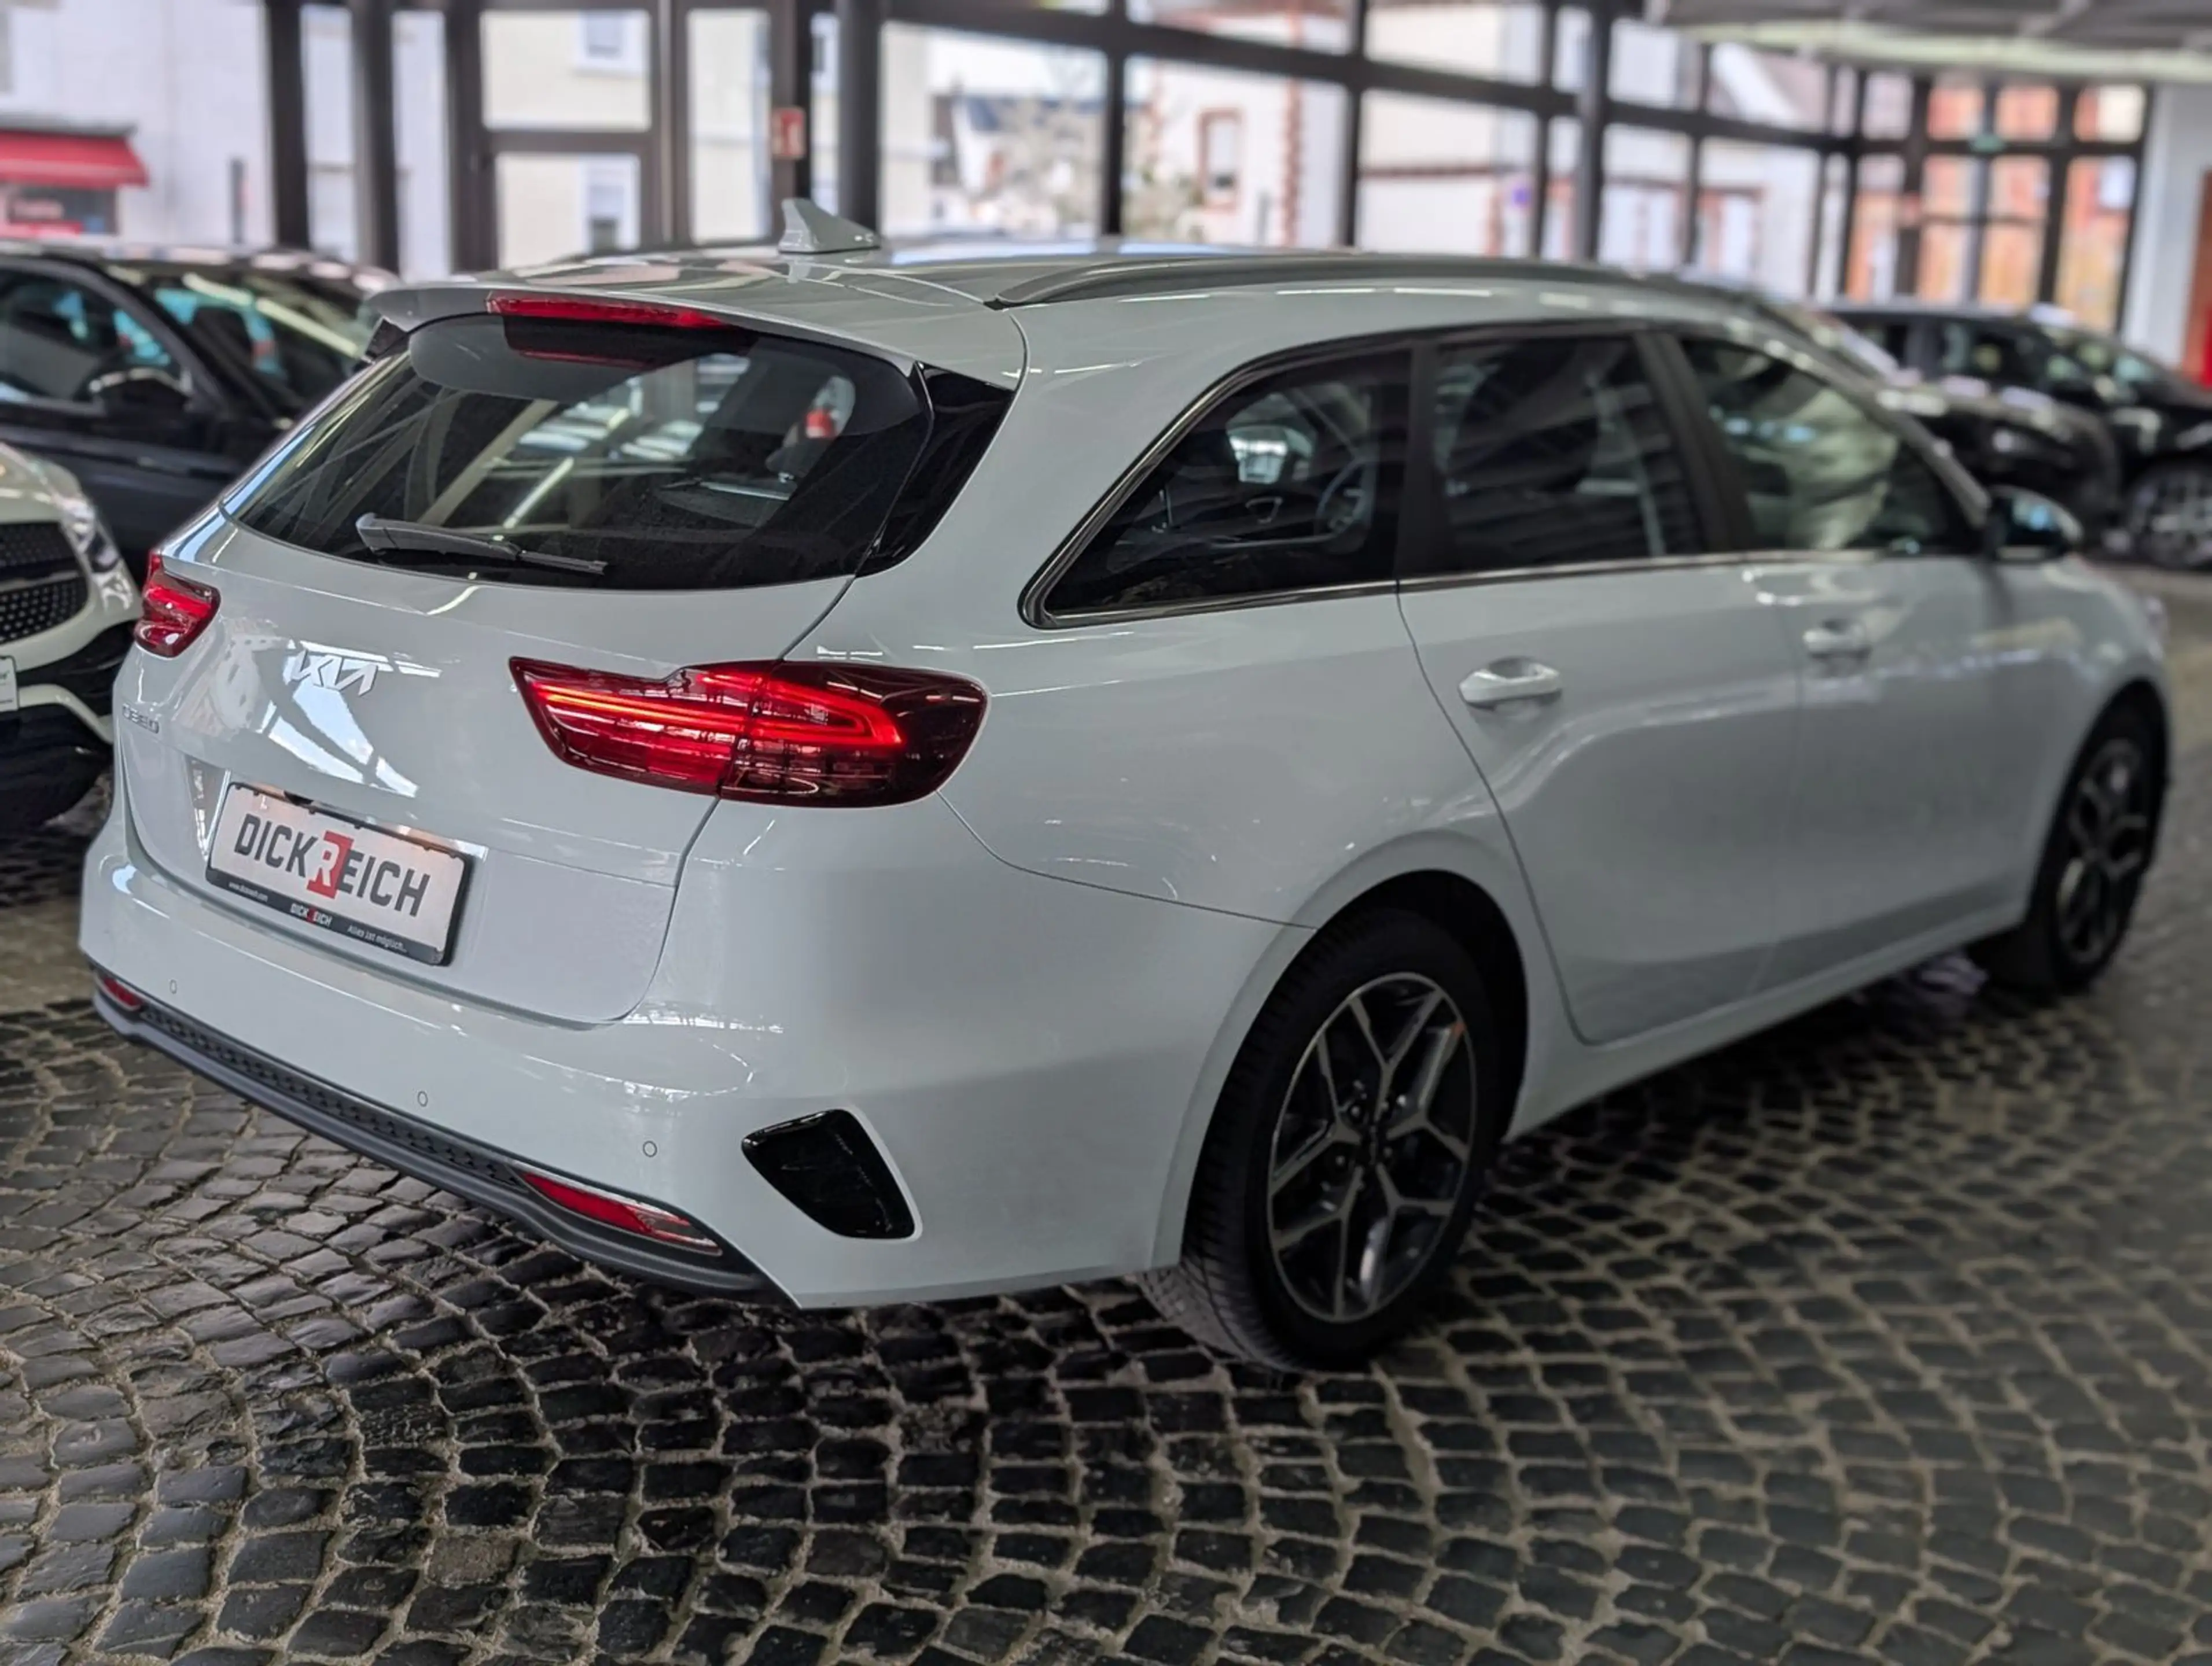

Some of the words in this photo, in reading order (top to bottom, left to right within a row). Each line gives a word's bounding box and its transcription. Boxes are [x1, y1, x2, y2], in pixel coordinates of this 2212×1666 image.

[291, 649, 379, 697] KIA
[233, 813, 430, 918] DICKREICH
[290, 903, 333, 926] DICKEICH
